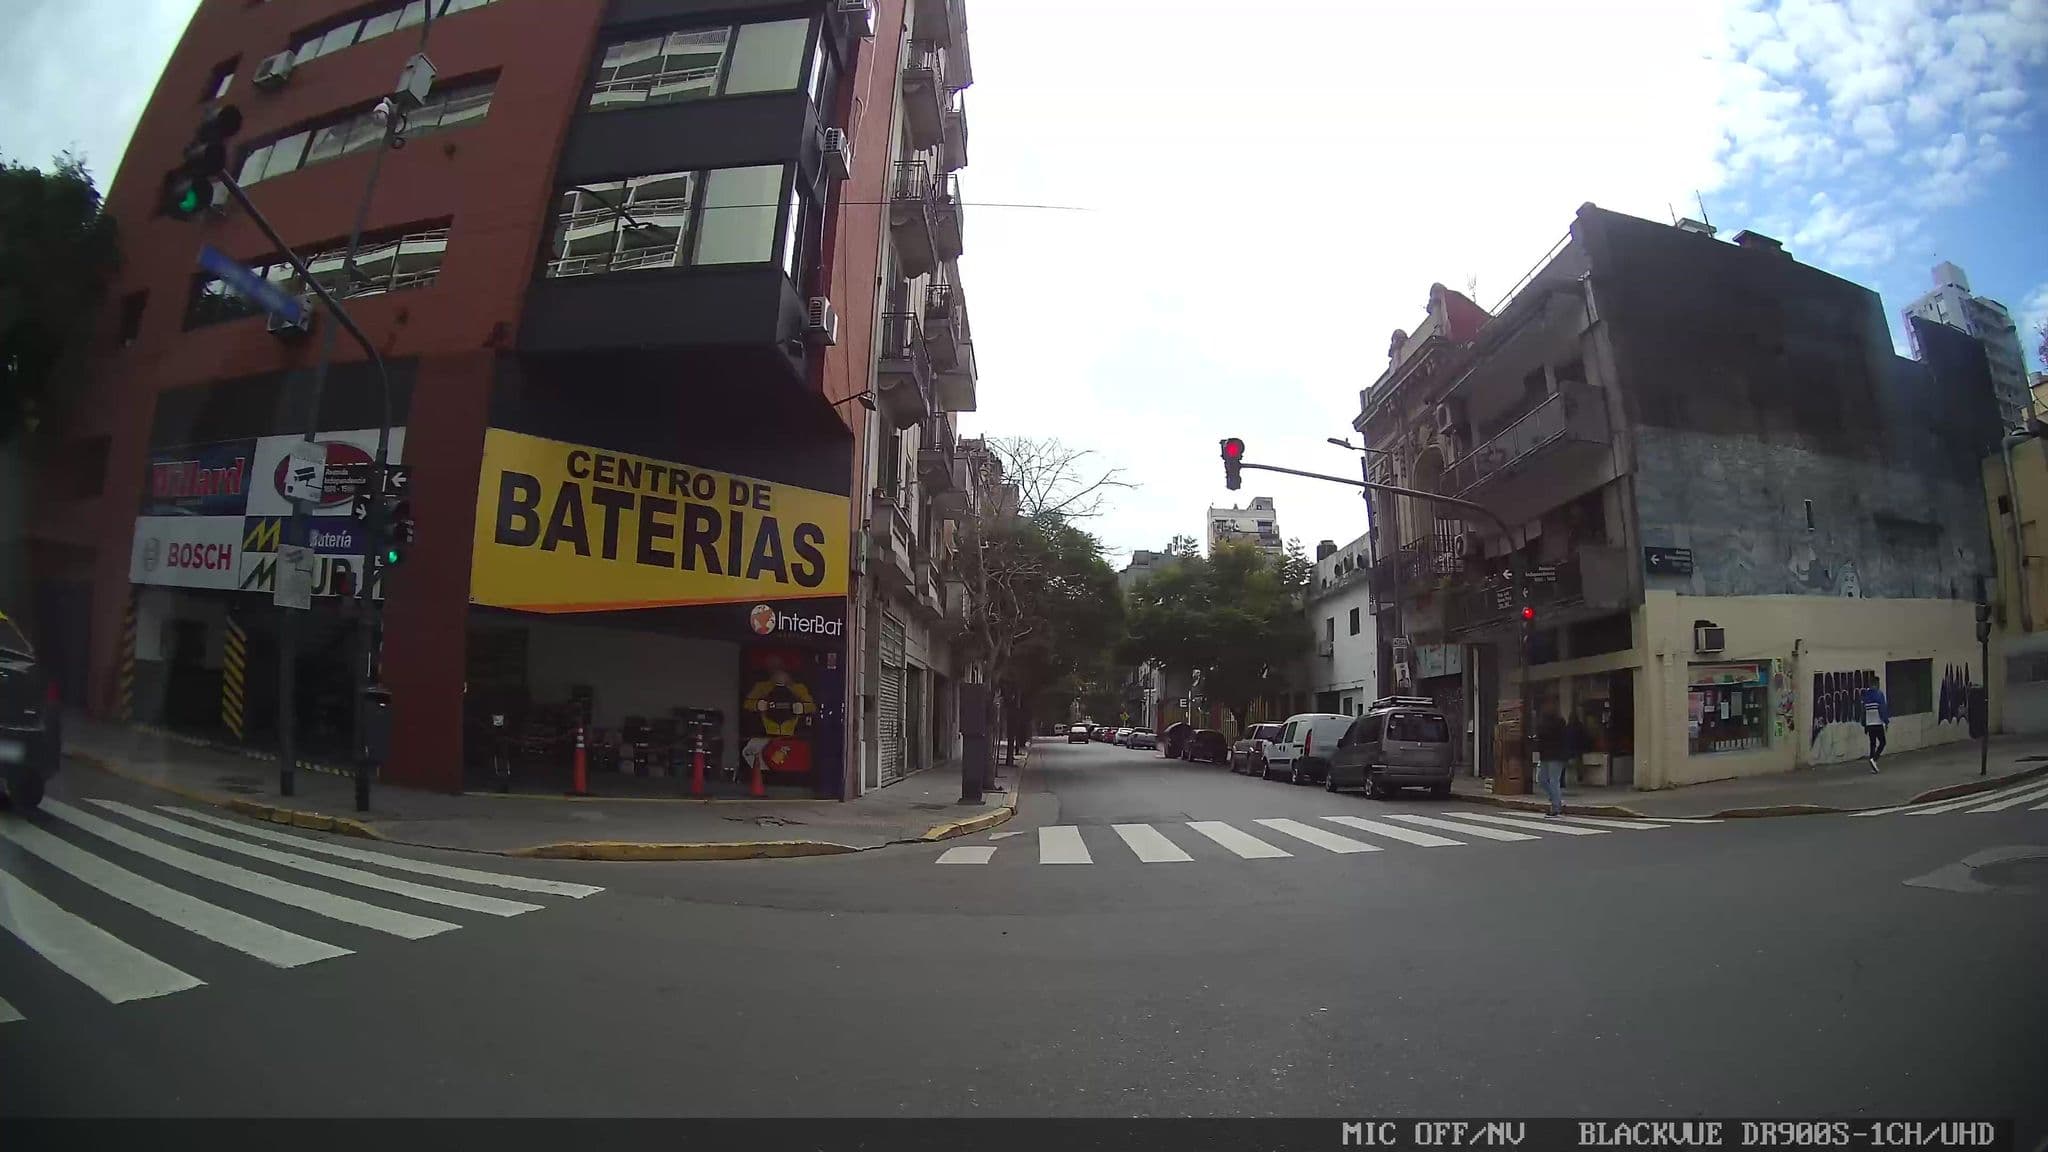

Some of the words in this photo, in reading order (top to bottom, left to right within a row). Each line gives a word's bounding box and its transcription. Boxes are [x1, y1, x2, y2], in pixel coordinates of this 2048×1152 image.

[566, 450, 716, 501] CENTRO
[728, 477, 771, 512] DE
[494, 469, 826, 588] BATERIAS
[167, 542, 233, 570] BOSCH
[777, 611, 843, 636] InterBat
